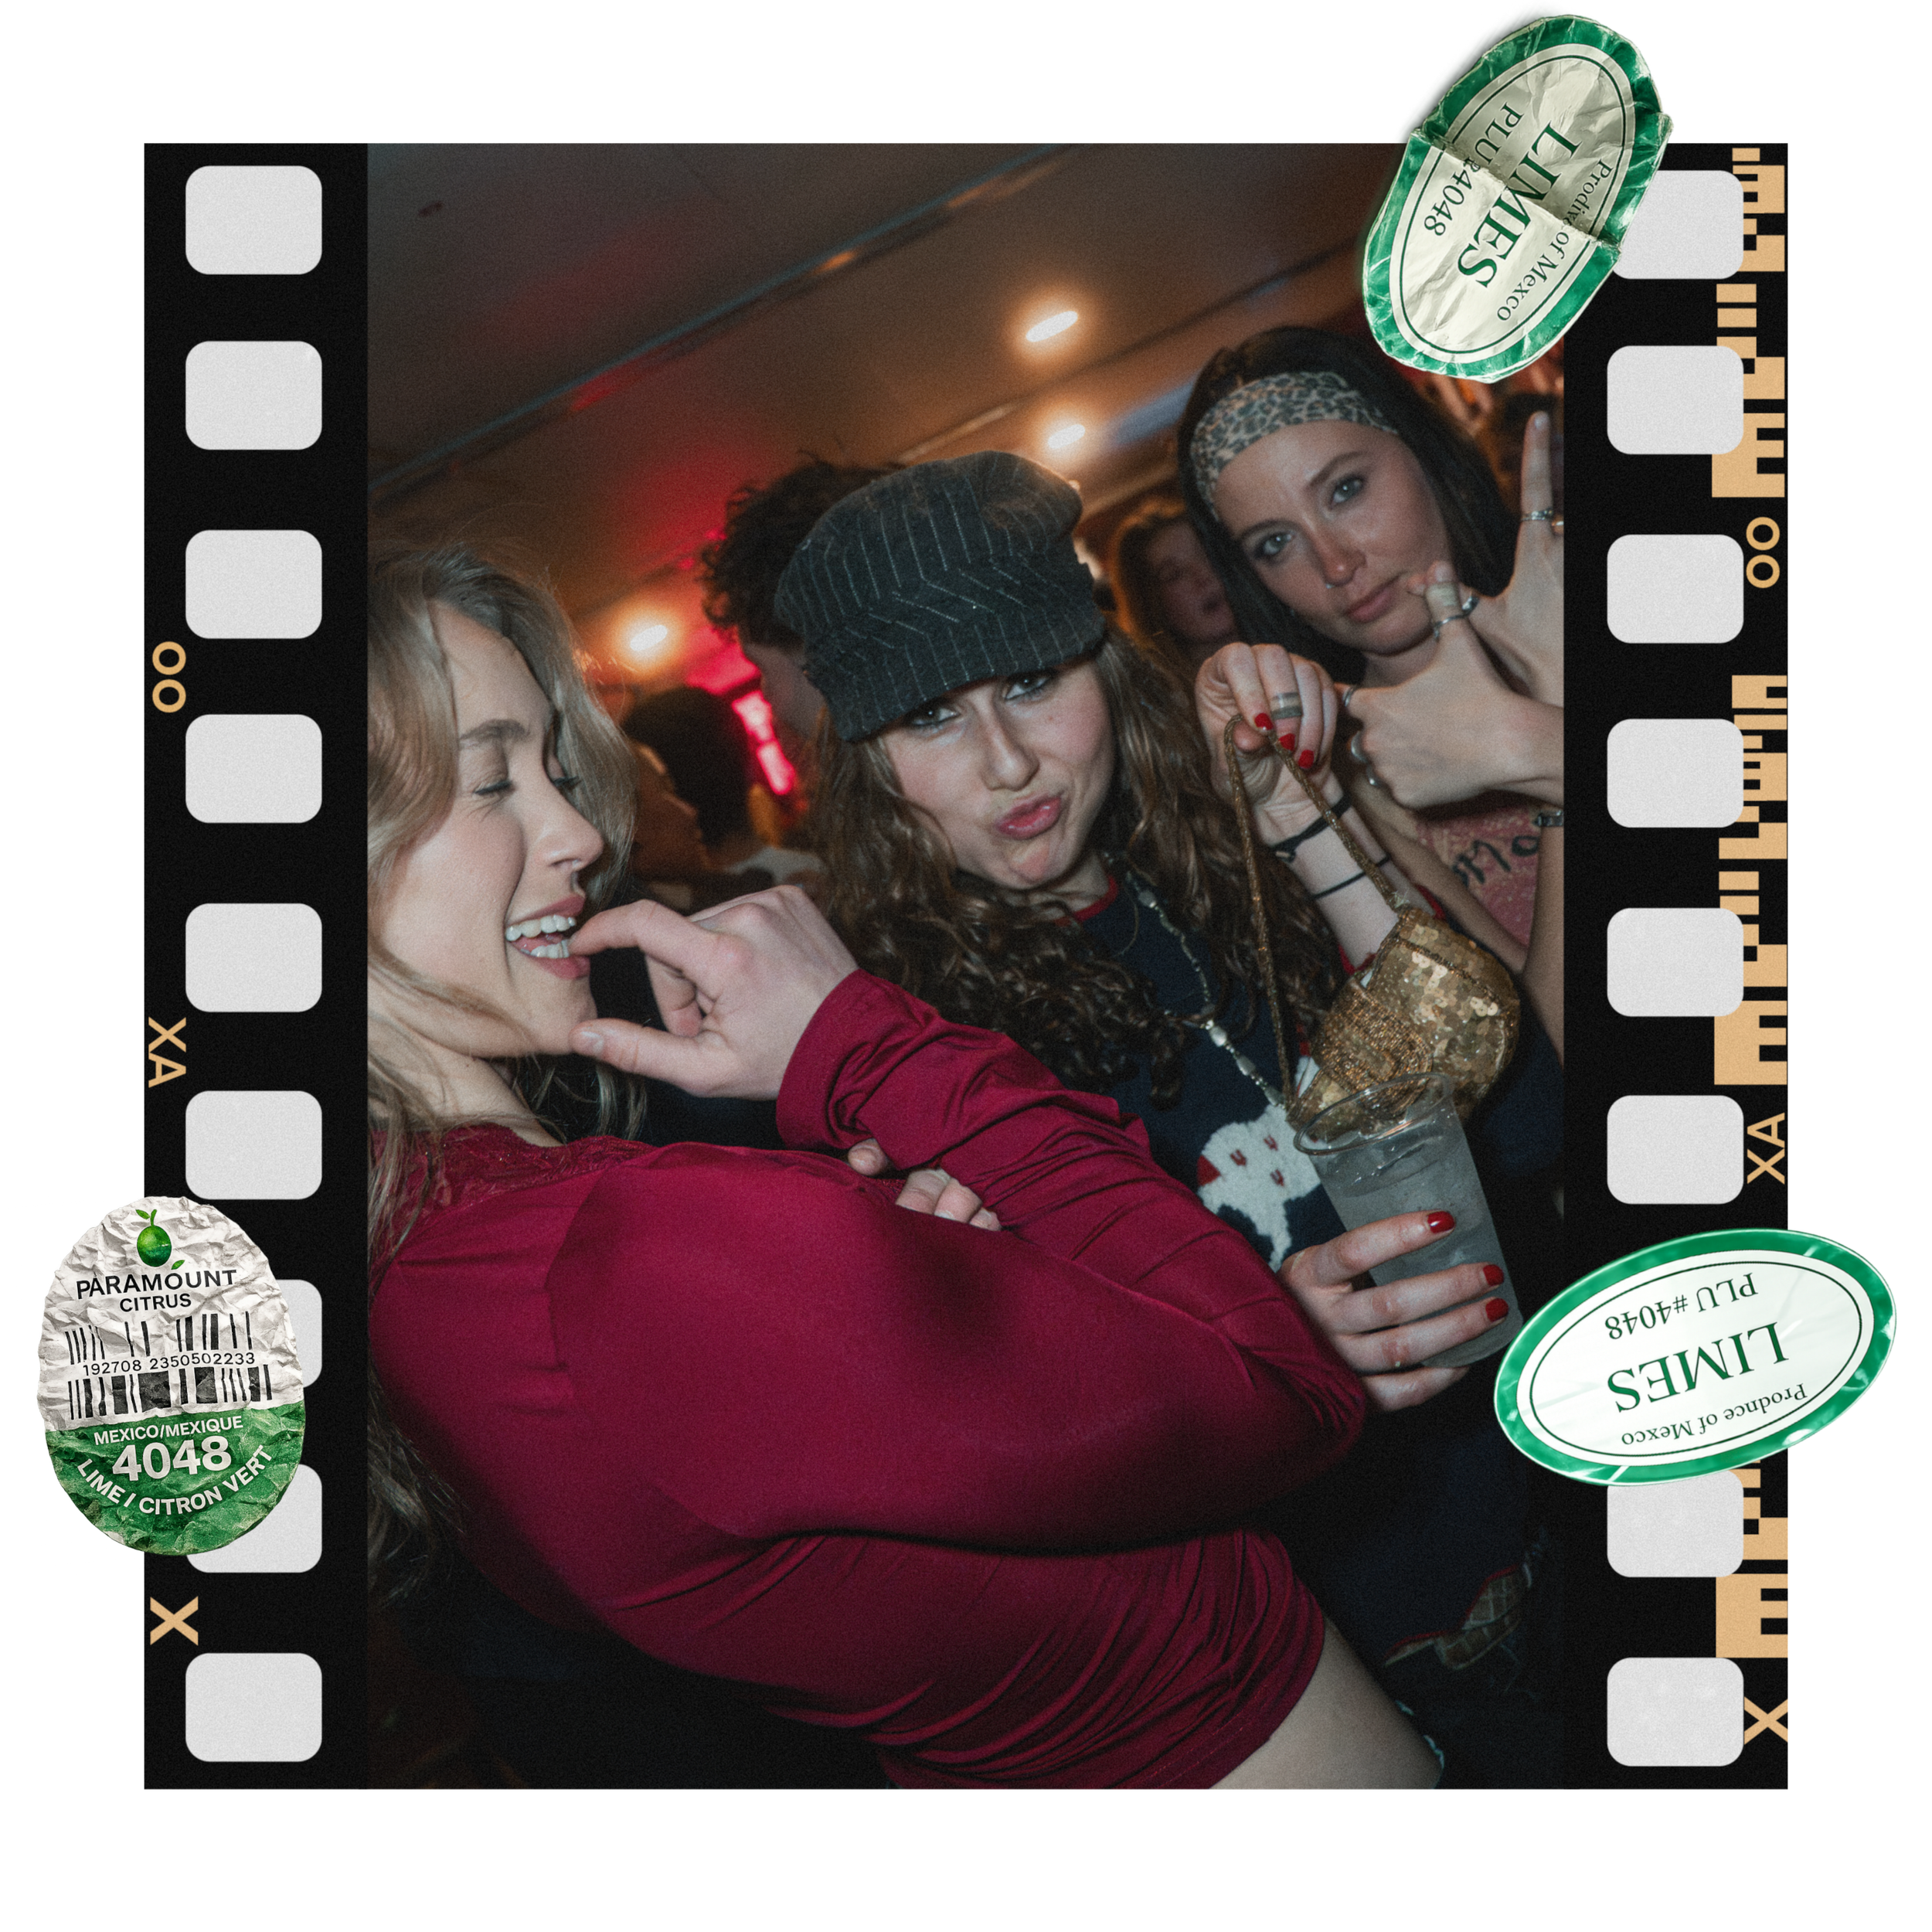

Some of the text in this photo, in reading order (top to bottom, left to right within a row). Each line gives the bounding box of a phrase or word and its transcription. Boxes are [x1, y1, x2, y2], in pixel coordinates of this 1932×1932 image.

[1475, 102, 1524, 165] PLU
[1458, 123, 1582, 287] LIMES
[1549, 232, 1569, 259] of
[1497, 253, 1559, 320] Mexco
[77, 1270, 236, 1299] PARAMOUNT
[120, 1293, 192, 1312] CITRUS
[1604, 1273, 1759, 1339] PLU #4048
[83, 1352, 255, 1376] 192708 2350502233
[1607, 1321, 1789, 1413] LIMES
[94, 1416, 243, 1445] MEXICO/MEXIQUE
[1621, 1420, 1694, 1446] Mexco
[1698, 1413, 1719, 1434] of
[112, 1436, 232, 1481] 4048
[77, 1458, 125, 1504] LIME
[139, 1486, 223, 1515] CITRON
[222, 1444, 272, 1492] VERT
